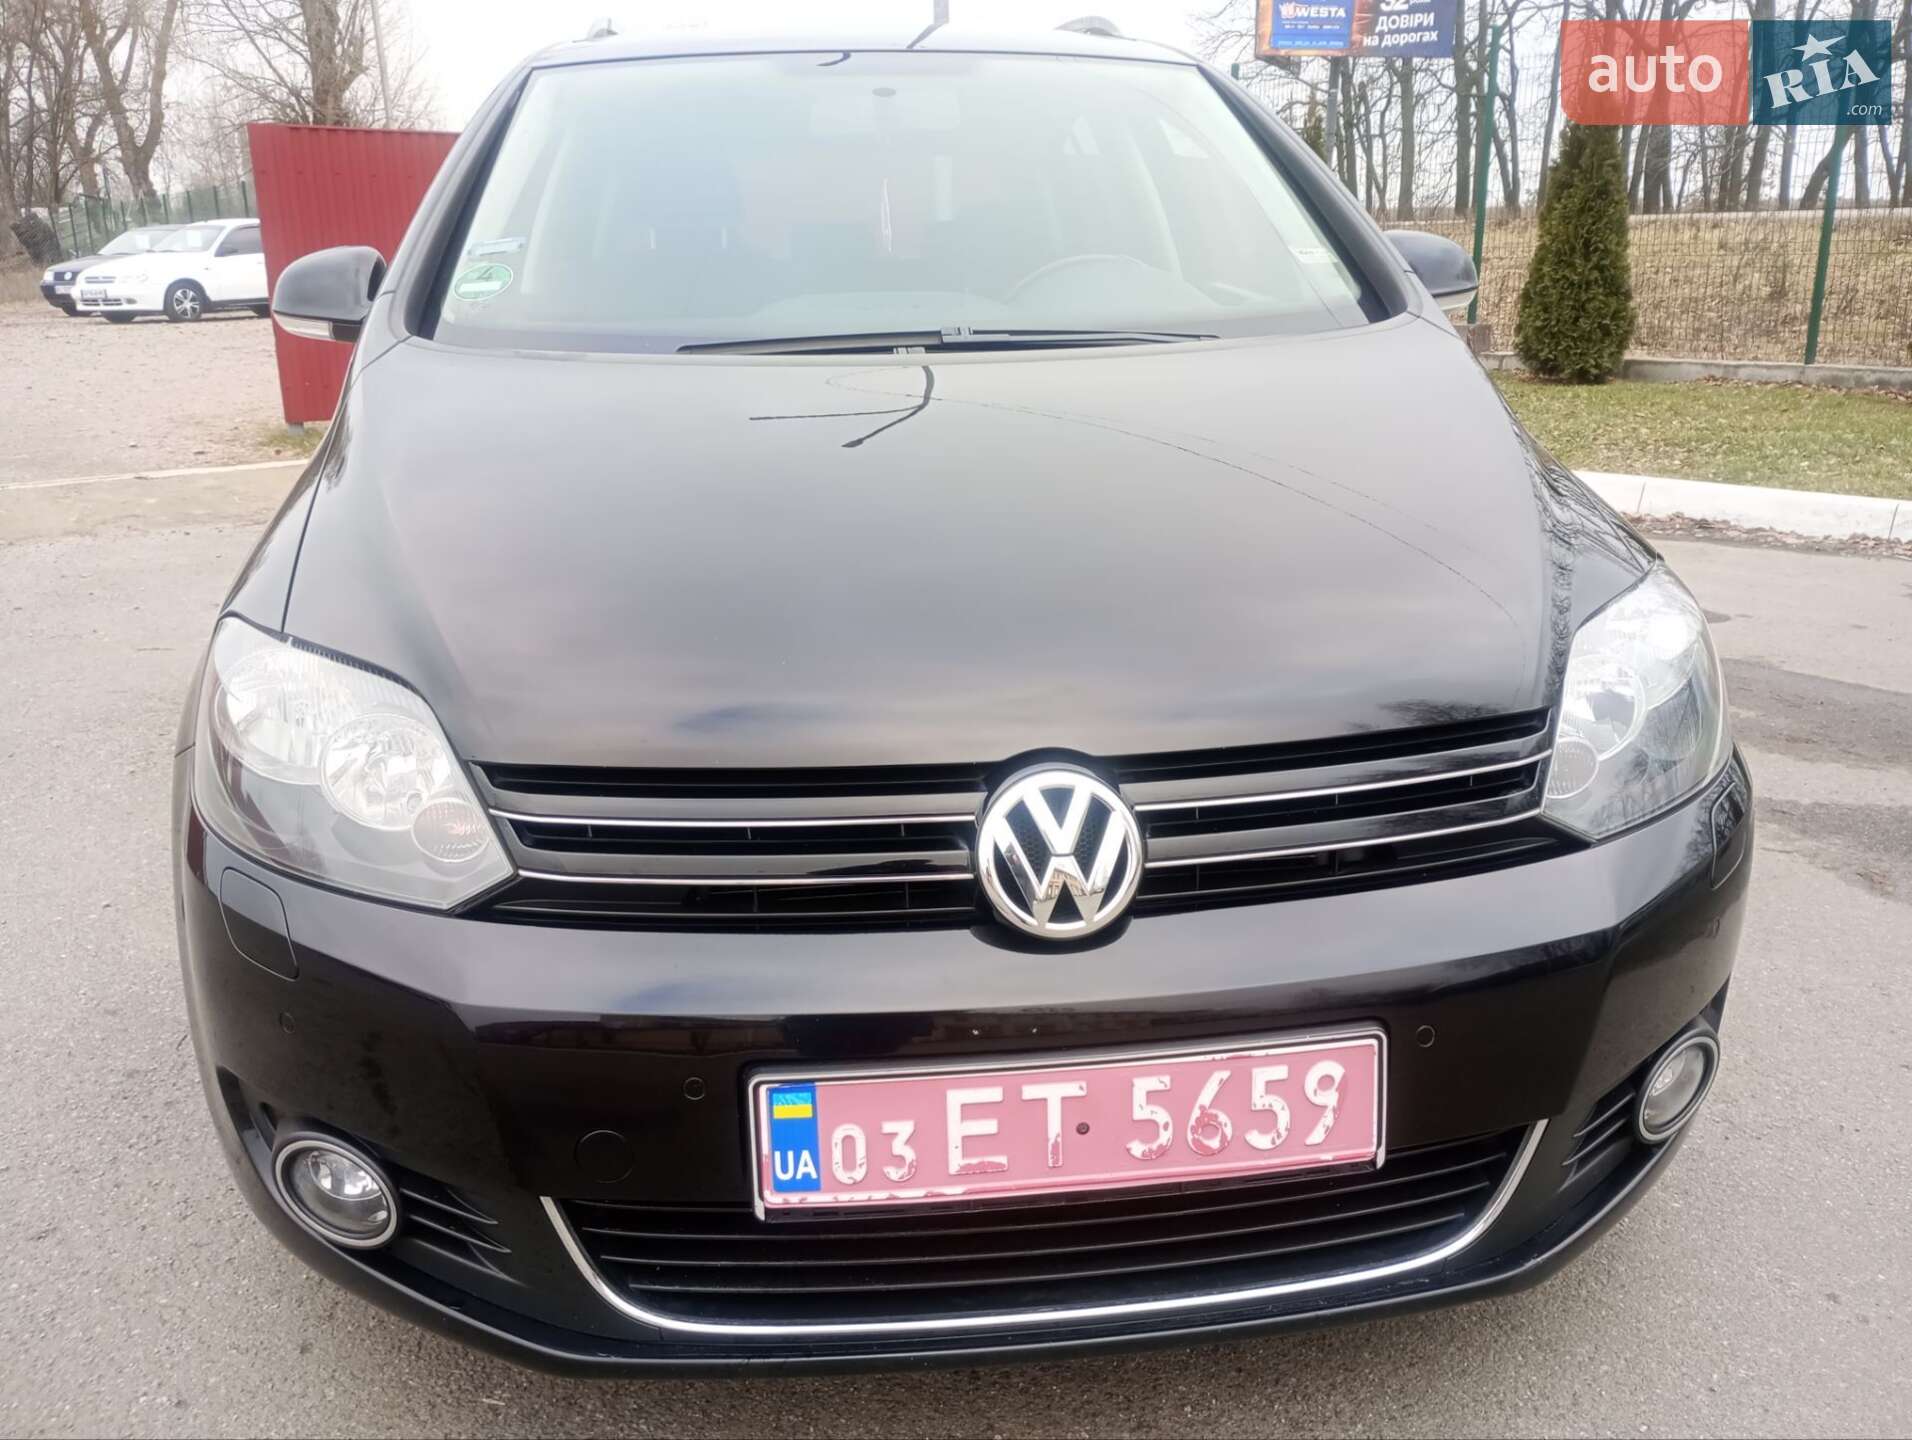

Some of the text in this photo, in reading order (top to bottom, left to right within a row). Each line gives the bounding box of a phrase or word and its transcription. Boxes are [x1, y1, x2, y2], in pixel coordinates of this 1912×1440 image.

[1295, 6, 1346, 18] WESTA
[1375, 12, 1435, 33] ДОВІРИ
[1363, 31, 1438, 48] на дорогах
[832, 1060, 1346, 1185] 03 ET 5659
[774, 1150, 818, 1180] UA
